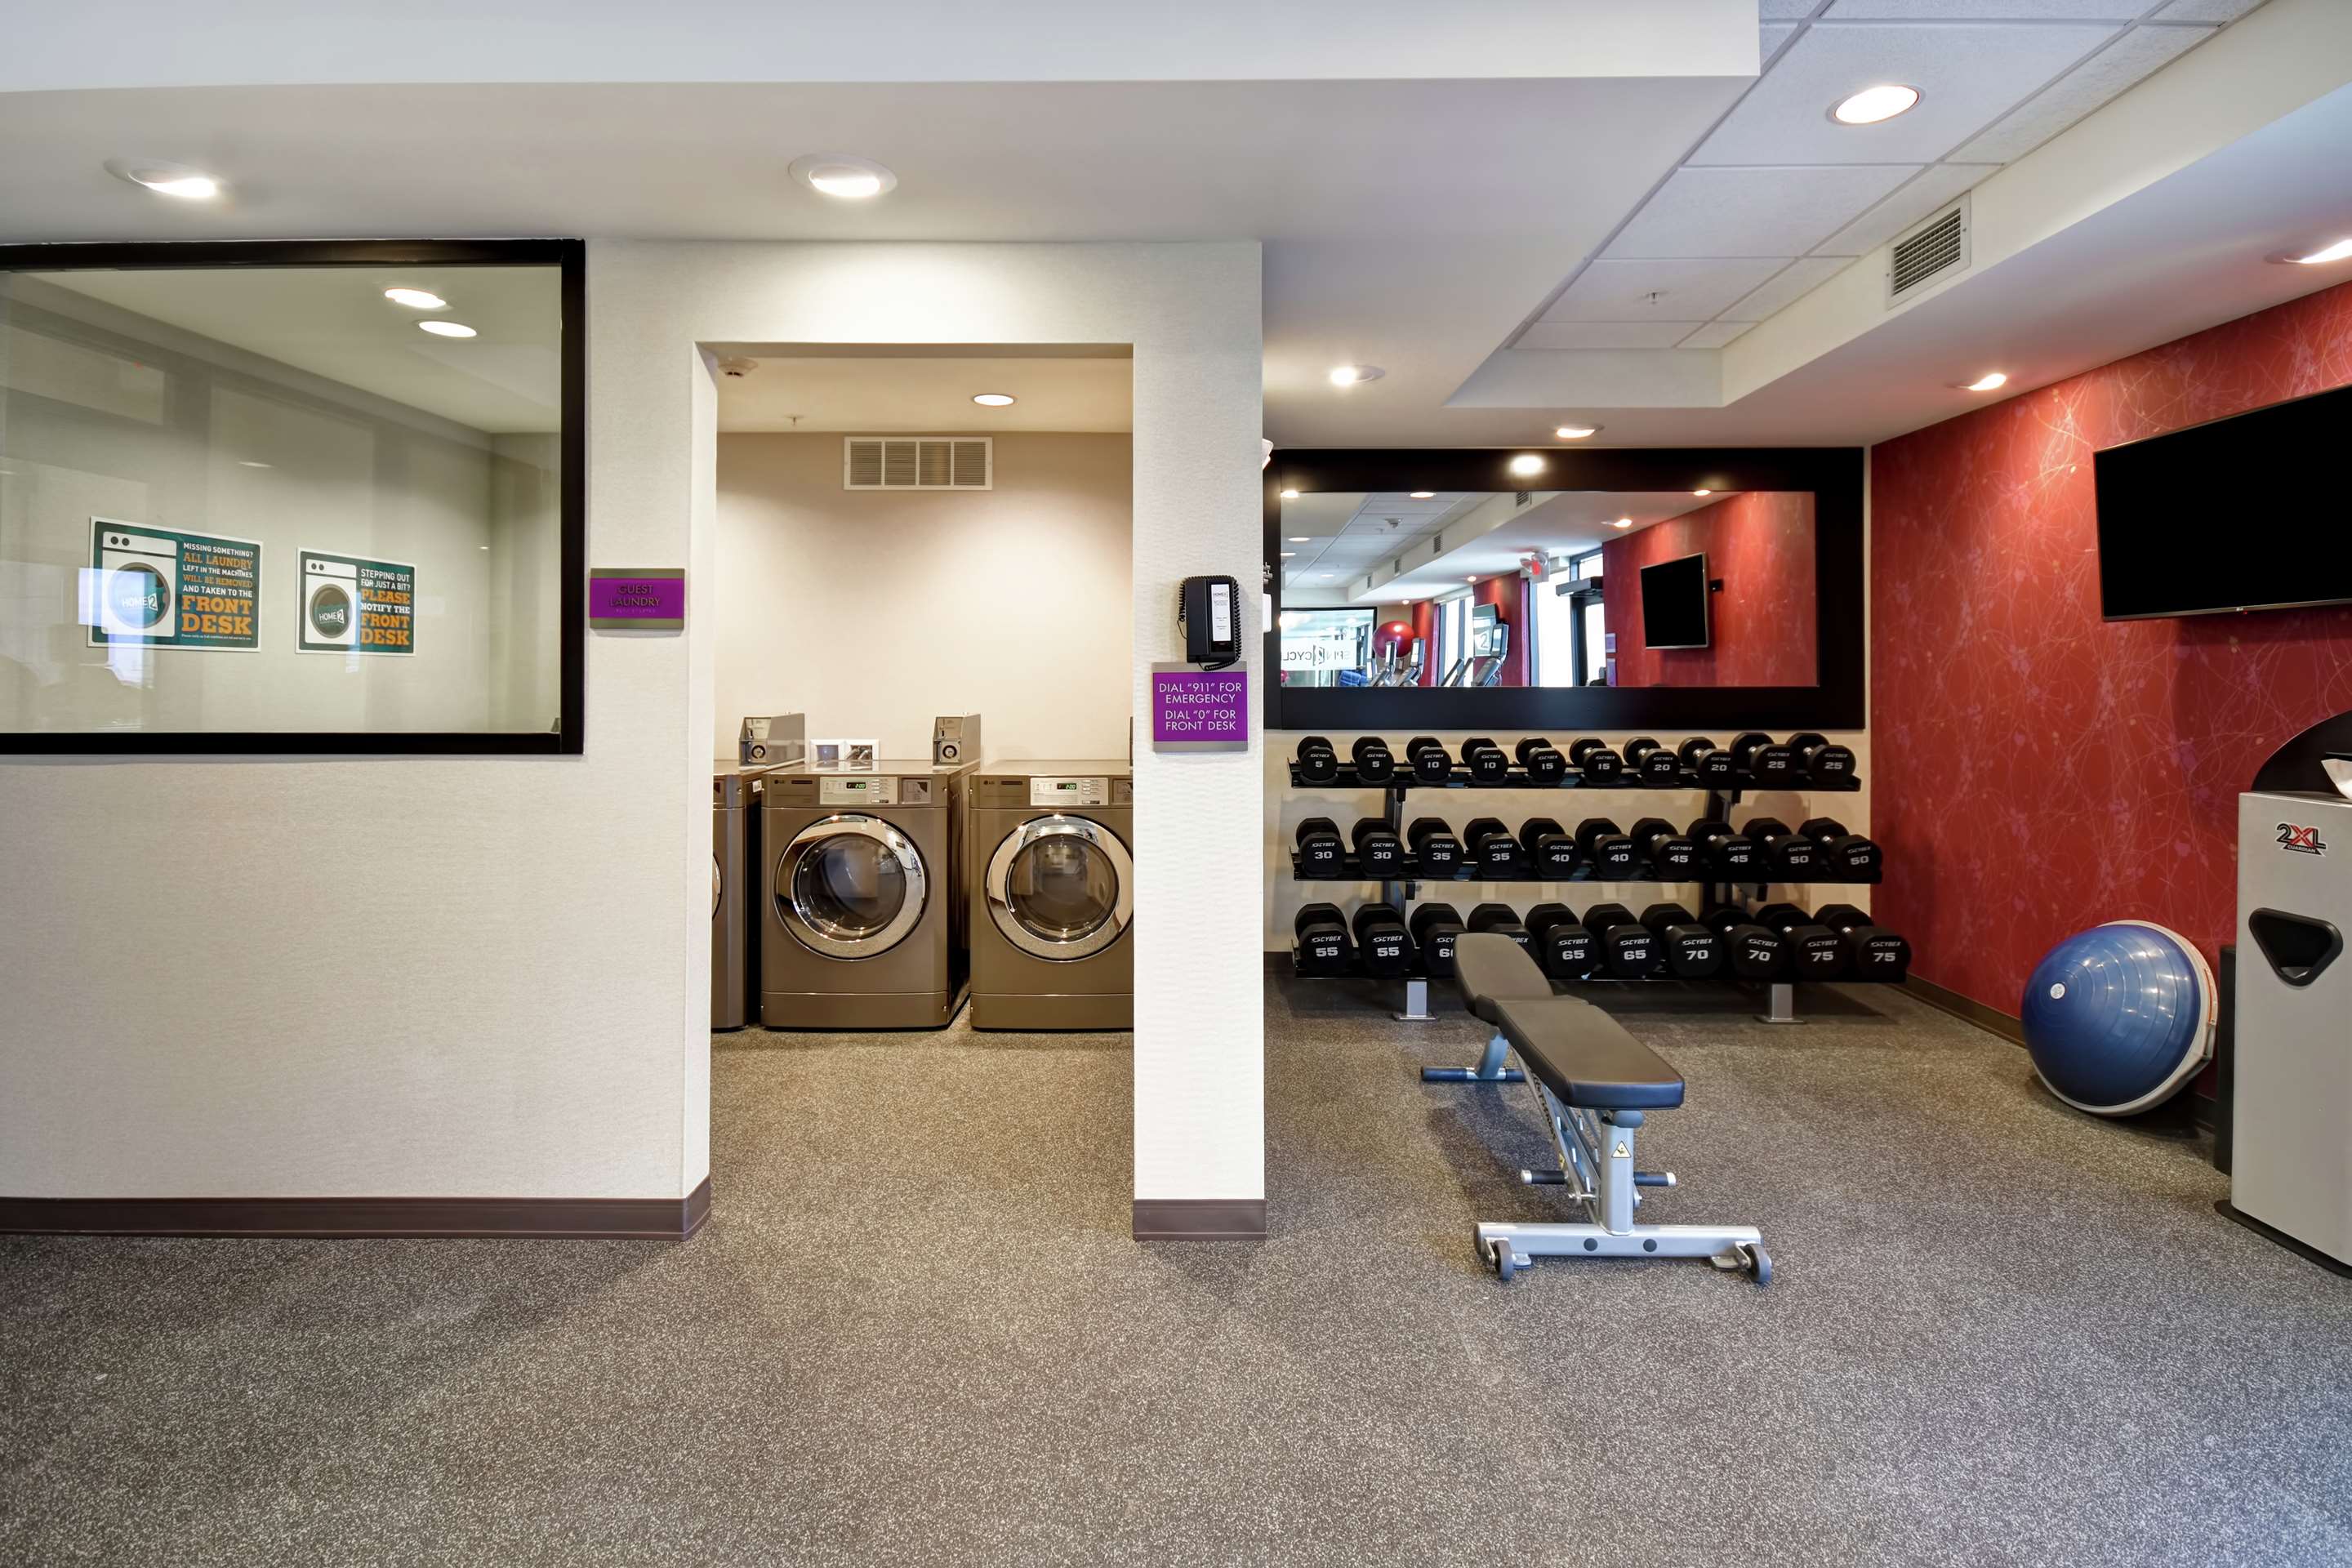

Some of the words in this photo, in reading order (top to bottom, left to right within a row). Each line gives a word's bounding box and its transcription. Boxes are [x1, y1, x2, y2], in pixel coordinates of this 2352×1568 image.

[183, 542, 212, 552] MISSING
[212, 546, 254, 558] SOMETHING?
[183, 552, 203, 564] ALL
[206, 555, 253, 569] LAUNDRY
[208, 567, 221, 575] THE
[221, 568, 253, 578] MACHINES
[360, 568, 395, 581] STEPPING
[396, 573, 411, 582] OUT
[182, 574, 203, 582] WILL
[204, 576, 213, 585] BE
[216, 577, 253, 588] REMOVED
[360, 578, 374, 587] FOR
[375, 581, 391, 590] JUST
[397, 582, 411, 591] BIT?
[182, 585, 199, 593] AND
[200, 586, 227, 595] TAKEN
[238, 590, 253, 598] THE
[617, 584, 654, 595] GUEST
[361, 588, 411, 604] PLEASE
[182, 595, 253, 615] FRONT
[609, 597, 661, 607] LAUNDRY
[360, 603, 392, 612] NOTIFY
[393, 605, 411, 614] THE
[181, 612, 252, 635] DESK
[361, 613, 411, 628] FRONT
[360, 627, 410, 645] DESK
[1159, 683, 1184, 693] DIAL
[1219, 682, 1241, 693] FOR
[1165, 693, 1236, 703] EMERGENCY
[1165, 710, 1191, 719] DIAL
[1214, 709, 1236, 719] FOR
[1165, 720, 1203, 731] FRONT
[1208, 720, 1236, 731] DESK
[1767, 761, 1786, 769] 25
[1824, 762, 1843, 770] 25
[2276, 823, 2327, 850] 2XL
[1314, 851, 1333, 859] 30
[1491, 853, 1511, 861] 35
[1610, 853, 1629, 862] 40
[1790, 856, 1809, 864] 50
[1850, 856, 1869, 865] 50
[1756, 939, 1780, 947] CYBEX
[1316, 947, 1339, 957] 55
[1377, 947, 1400, 957] 55
[1439, 948, 1454, 958] 6
[1561, 950, 1586, 960] 65
[1624, 950, 1646, 960] 65
[1686, 950, 1708, 960] 70
[1748, 950, 1771, 961] 70
[1811, 951, 1833, 962] 75
[1873, 952, 1895, 962] 75
